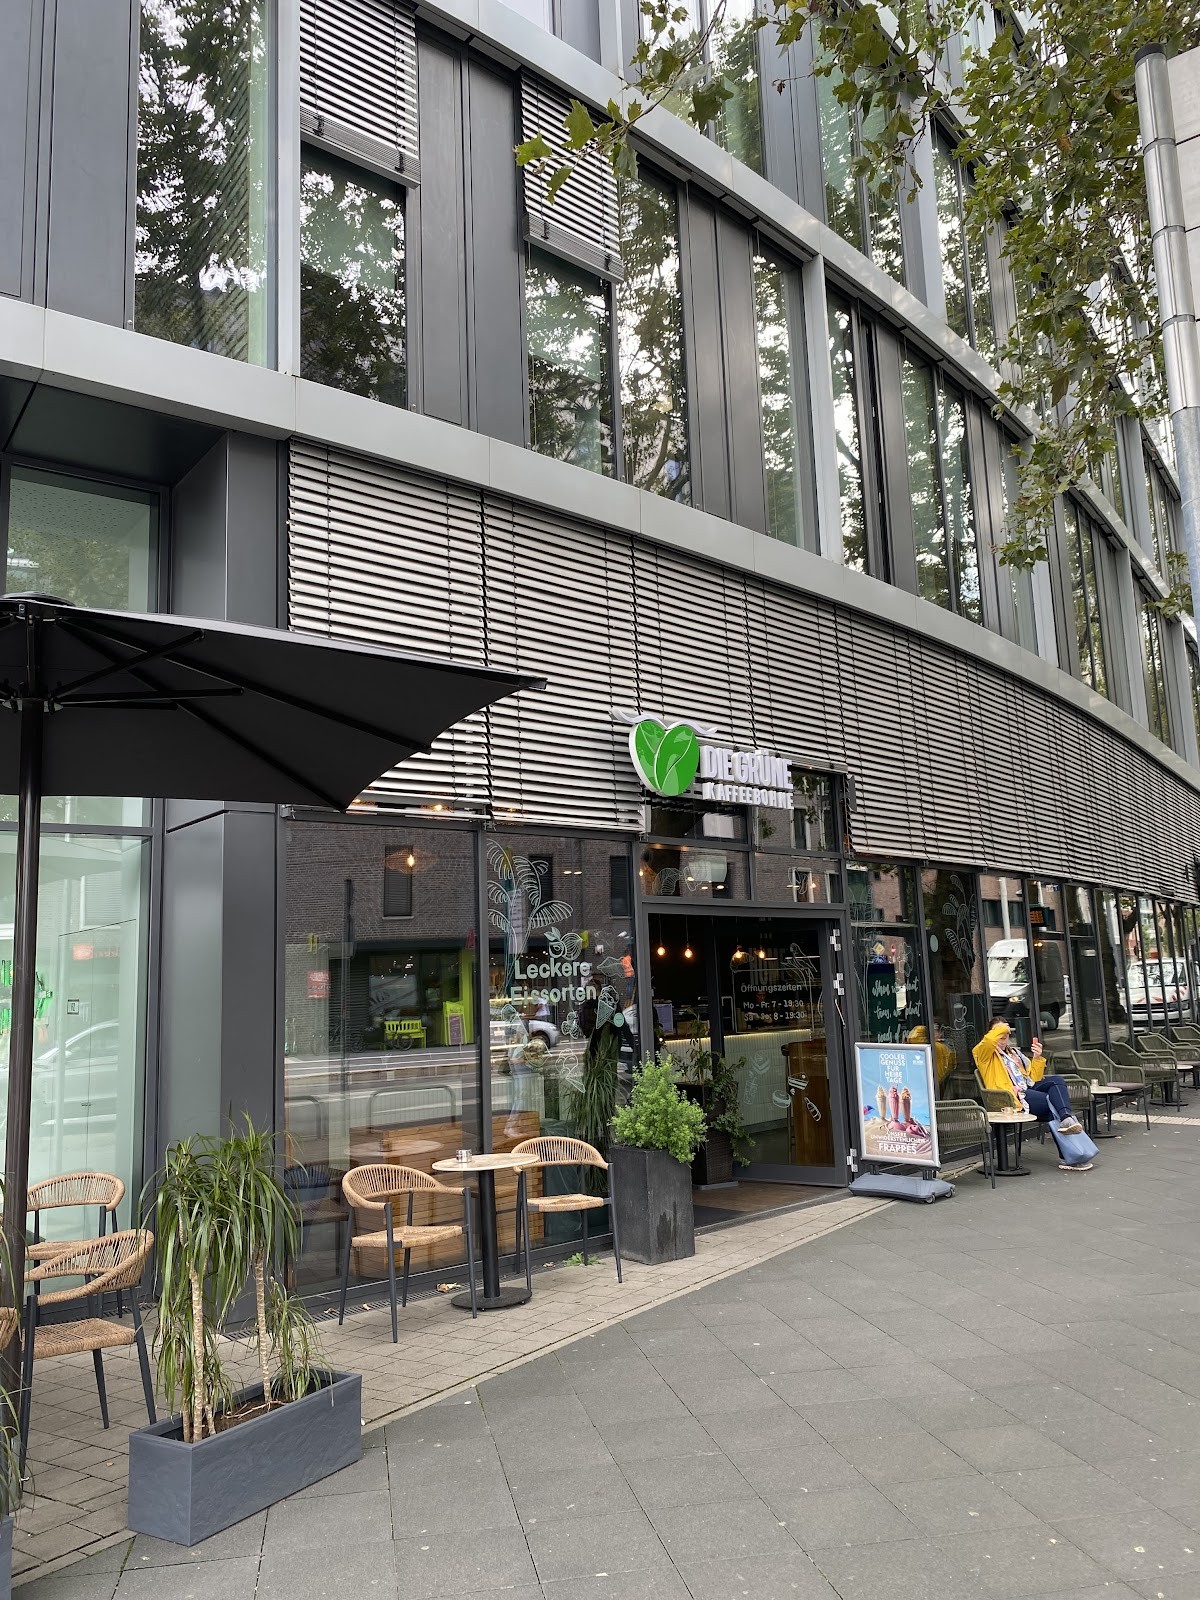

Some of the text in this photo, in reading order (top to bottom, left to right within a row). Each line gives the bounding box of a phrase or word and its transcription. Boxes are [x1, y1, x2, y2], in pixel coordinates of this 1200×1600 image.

[700, 745, 793, 790] DIE GRÜNE
[702, 782, 794, 810] KAFFEEBOHNE
[514, 957, 591, 980] Leckere
[510, 984, 597, 1006] Eissorten
[741, 982, 802, 993] Öffnungszeiten
[743, 1001, 755, 1010] Mo
[744, 1013, 754, 1021] Sa
